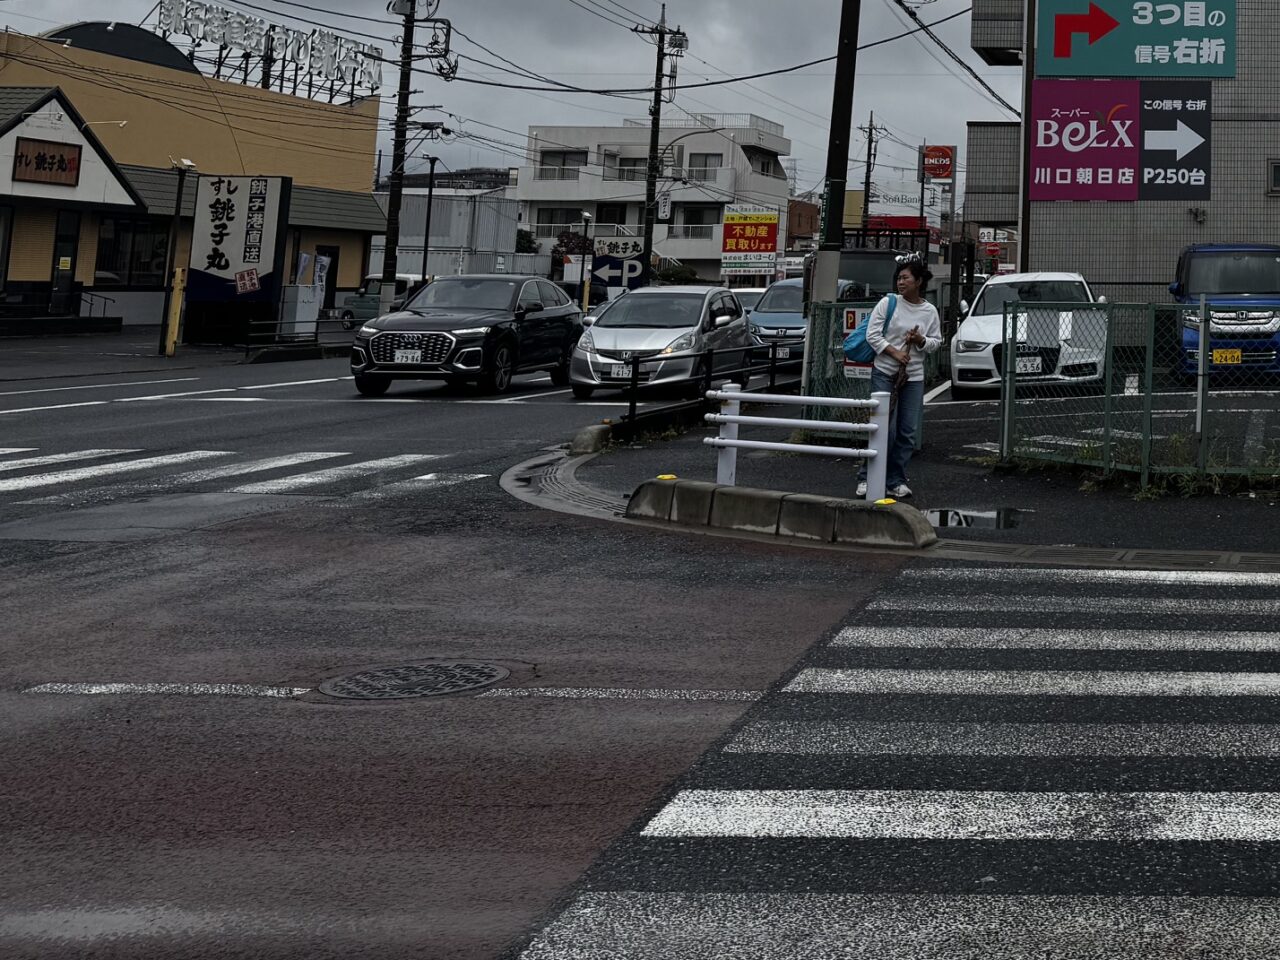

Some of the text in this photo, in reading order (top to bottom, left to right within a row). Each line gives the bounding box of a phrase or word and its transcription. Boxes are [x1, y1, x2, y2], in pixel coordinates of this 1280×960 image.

[1133, 1, 1226, 27] 3つ目の
[1135, 38, 1226, 65] 信号右折
[1051, 108, 1090, 118] スーパー
[1144, 100, 1207, 110] この信号 右折
[35, 152, 67, 172] 銚子丸
[1034, 168, 1134, 184] 川口朝日店
[1143, 168, 1206, 185] P250台
[210, 178, 238, 196] すし
[243, 179, 268, 263] 銚子港直送
[204, 198, 235, 270] 銚子丸
[732, 225, 768, 237] 不動産
[607, 241, 642, 253] 銚子丸
[725, 238, 773, 250] 買取ります
[622, 260, 643, 286] P
[847, 313, 855, 328] P
